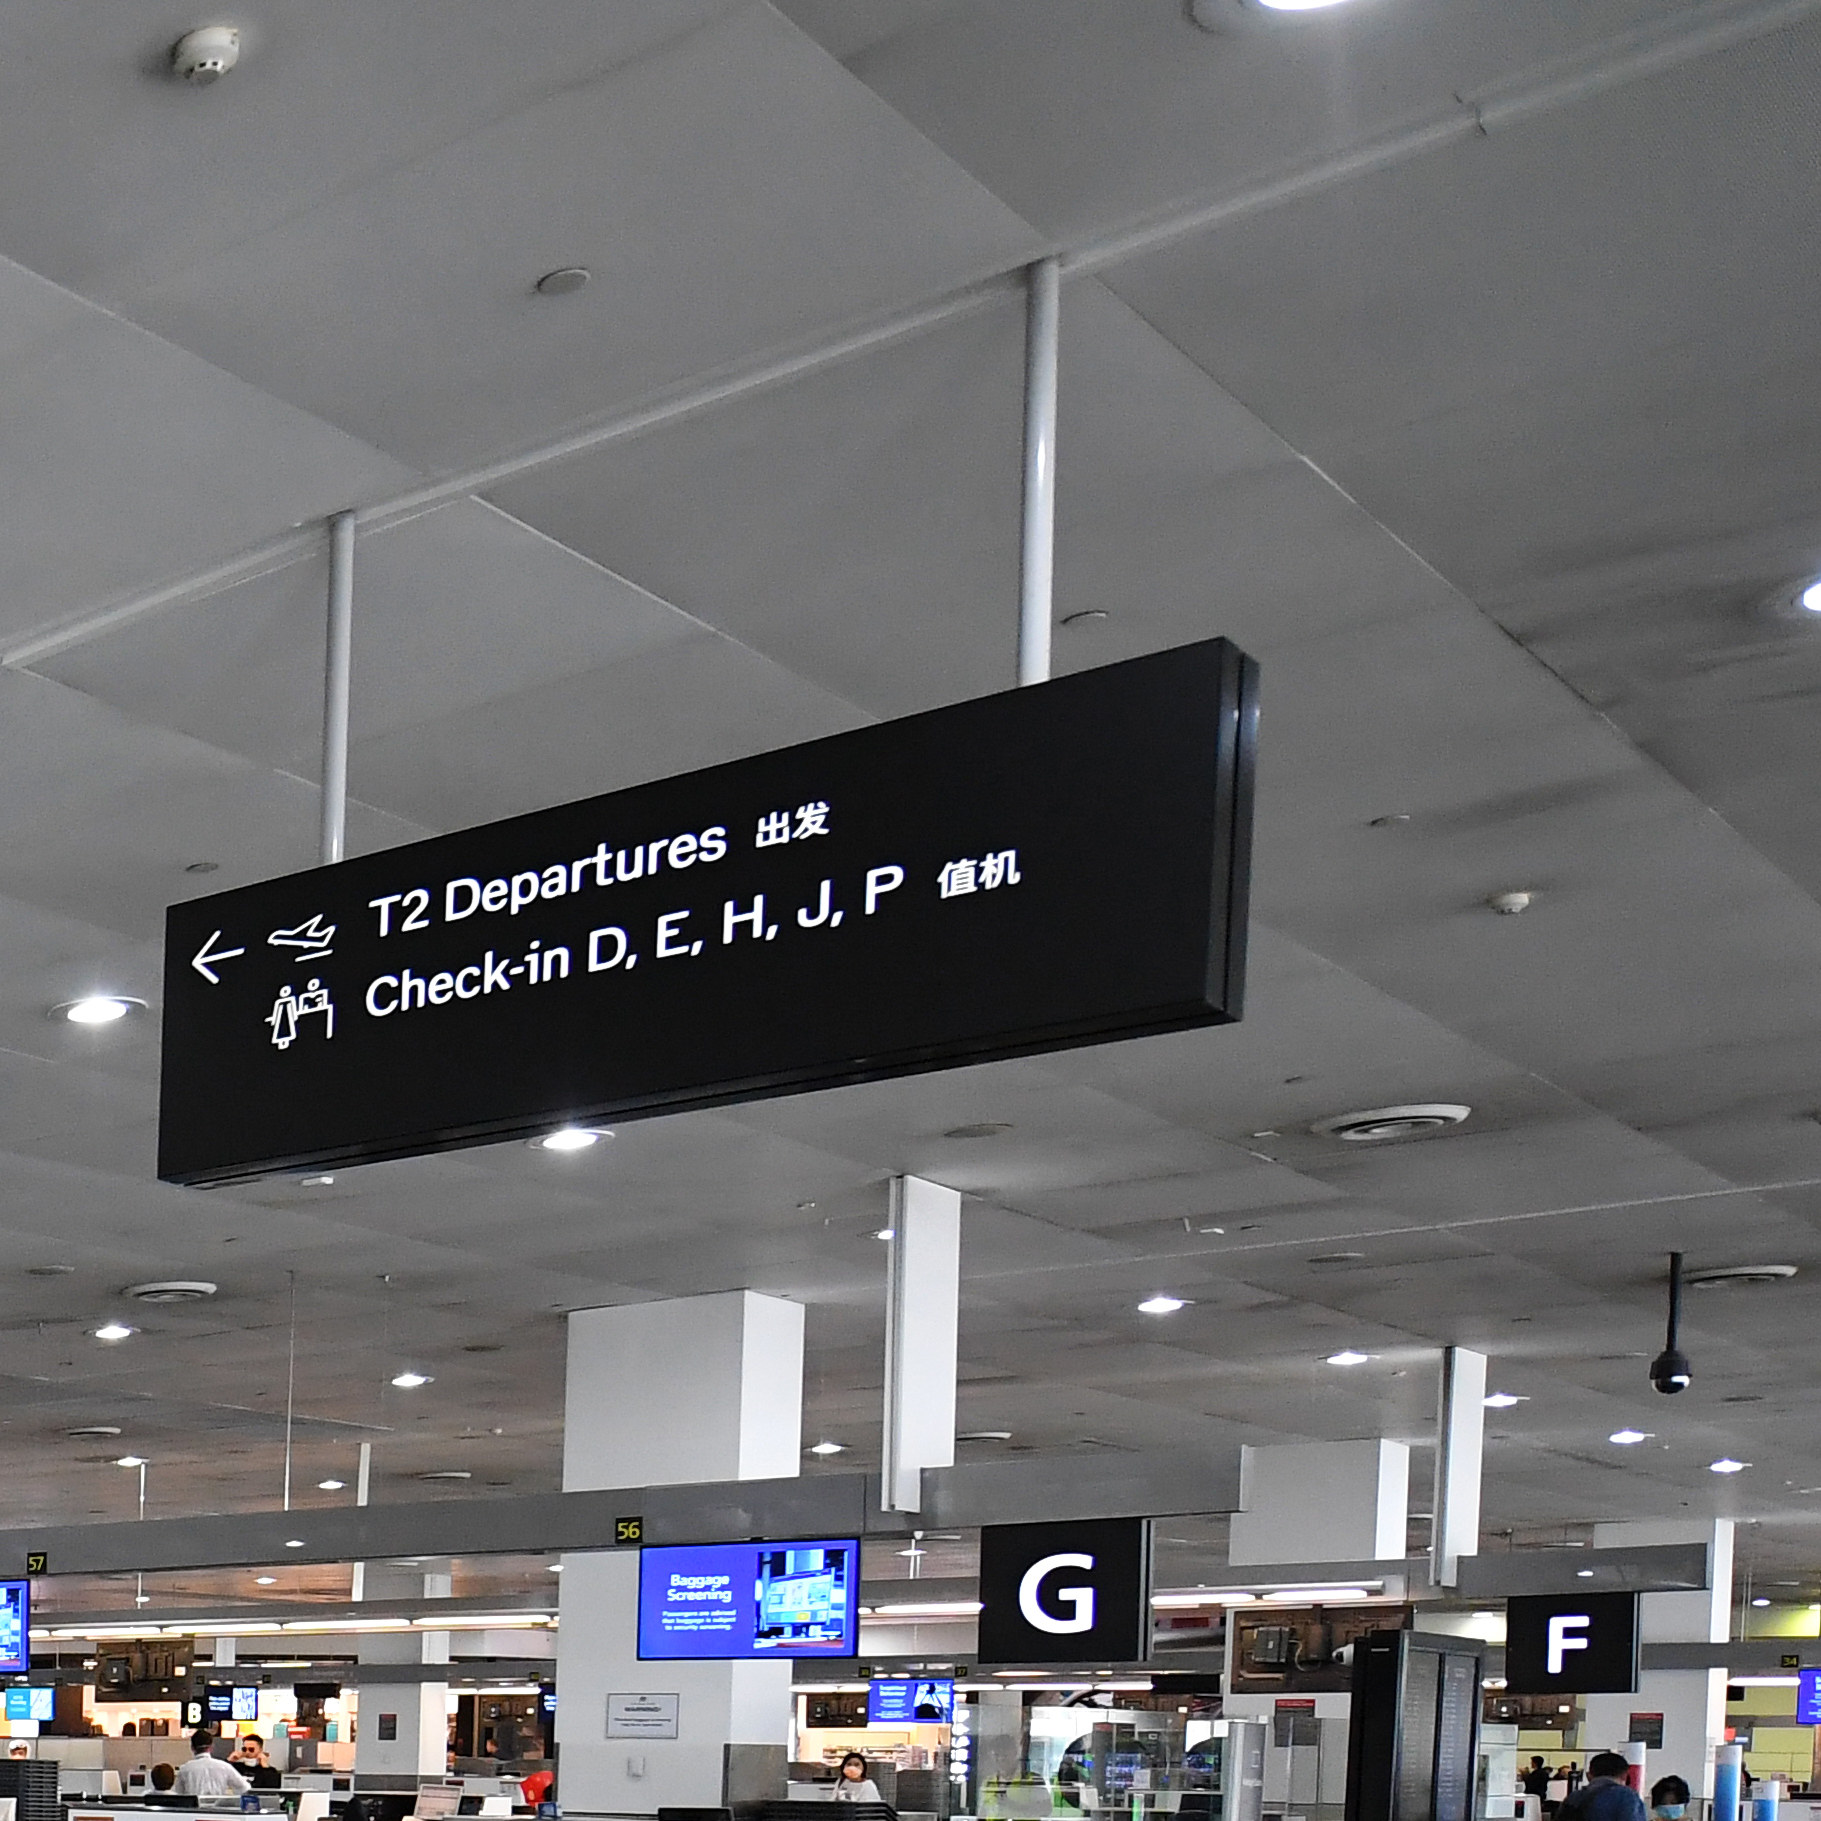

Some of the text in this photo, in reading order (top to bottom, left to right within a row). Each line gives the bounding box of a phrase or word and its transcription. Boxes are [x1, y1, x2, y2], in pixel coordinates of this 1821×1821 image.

[368, 800, 830, 937] T2 Departures 出发
[365, 849, 1022, 1017] Check-in D, E, H, J, P 值机
[617, 1522, 640, 1540] 56
[28, 1556, 45, 1571] 57
[670, 1574, 730, 1589] Baggage
[667, 1588, 732, 1603] Screening
[1019, 1553, 1095, 1634] G
[1547, 1615, 1590, 1674] F
[188, 1702, 202, 1723] B
